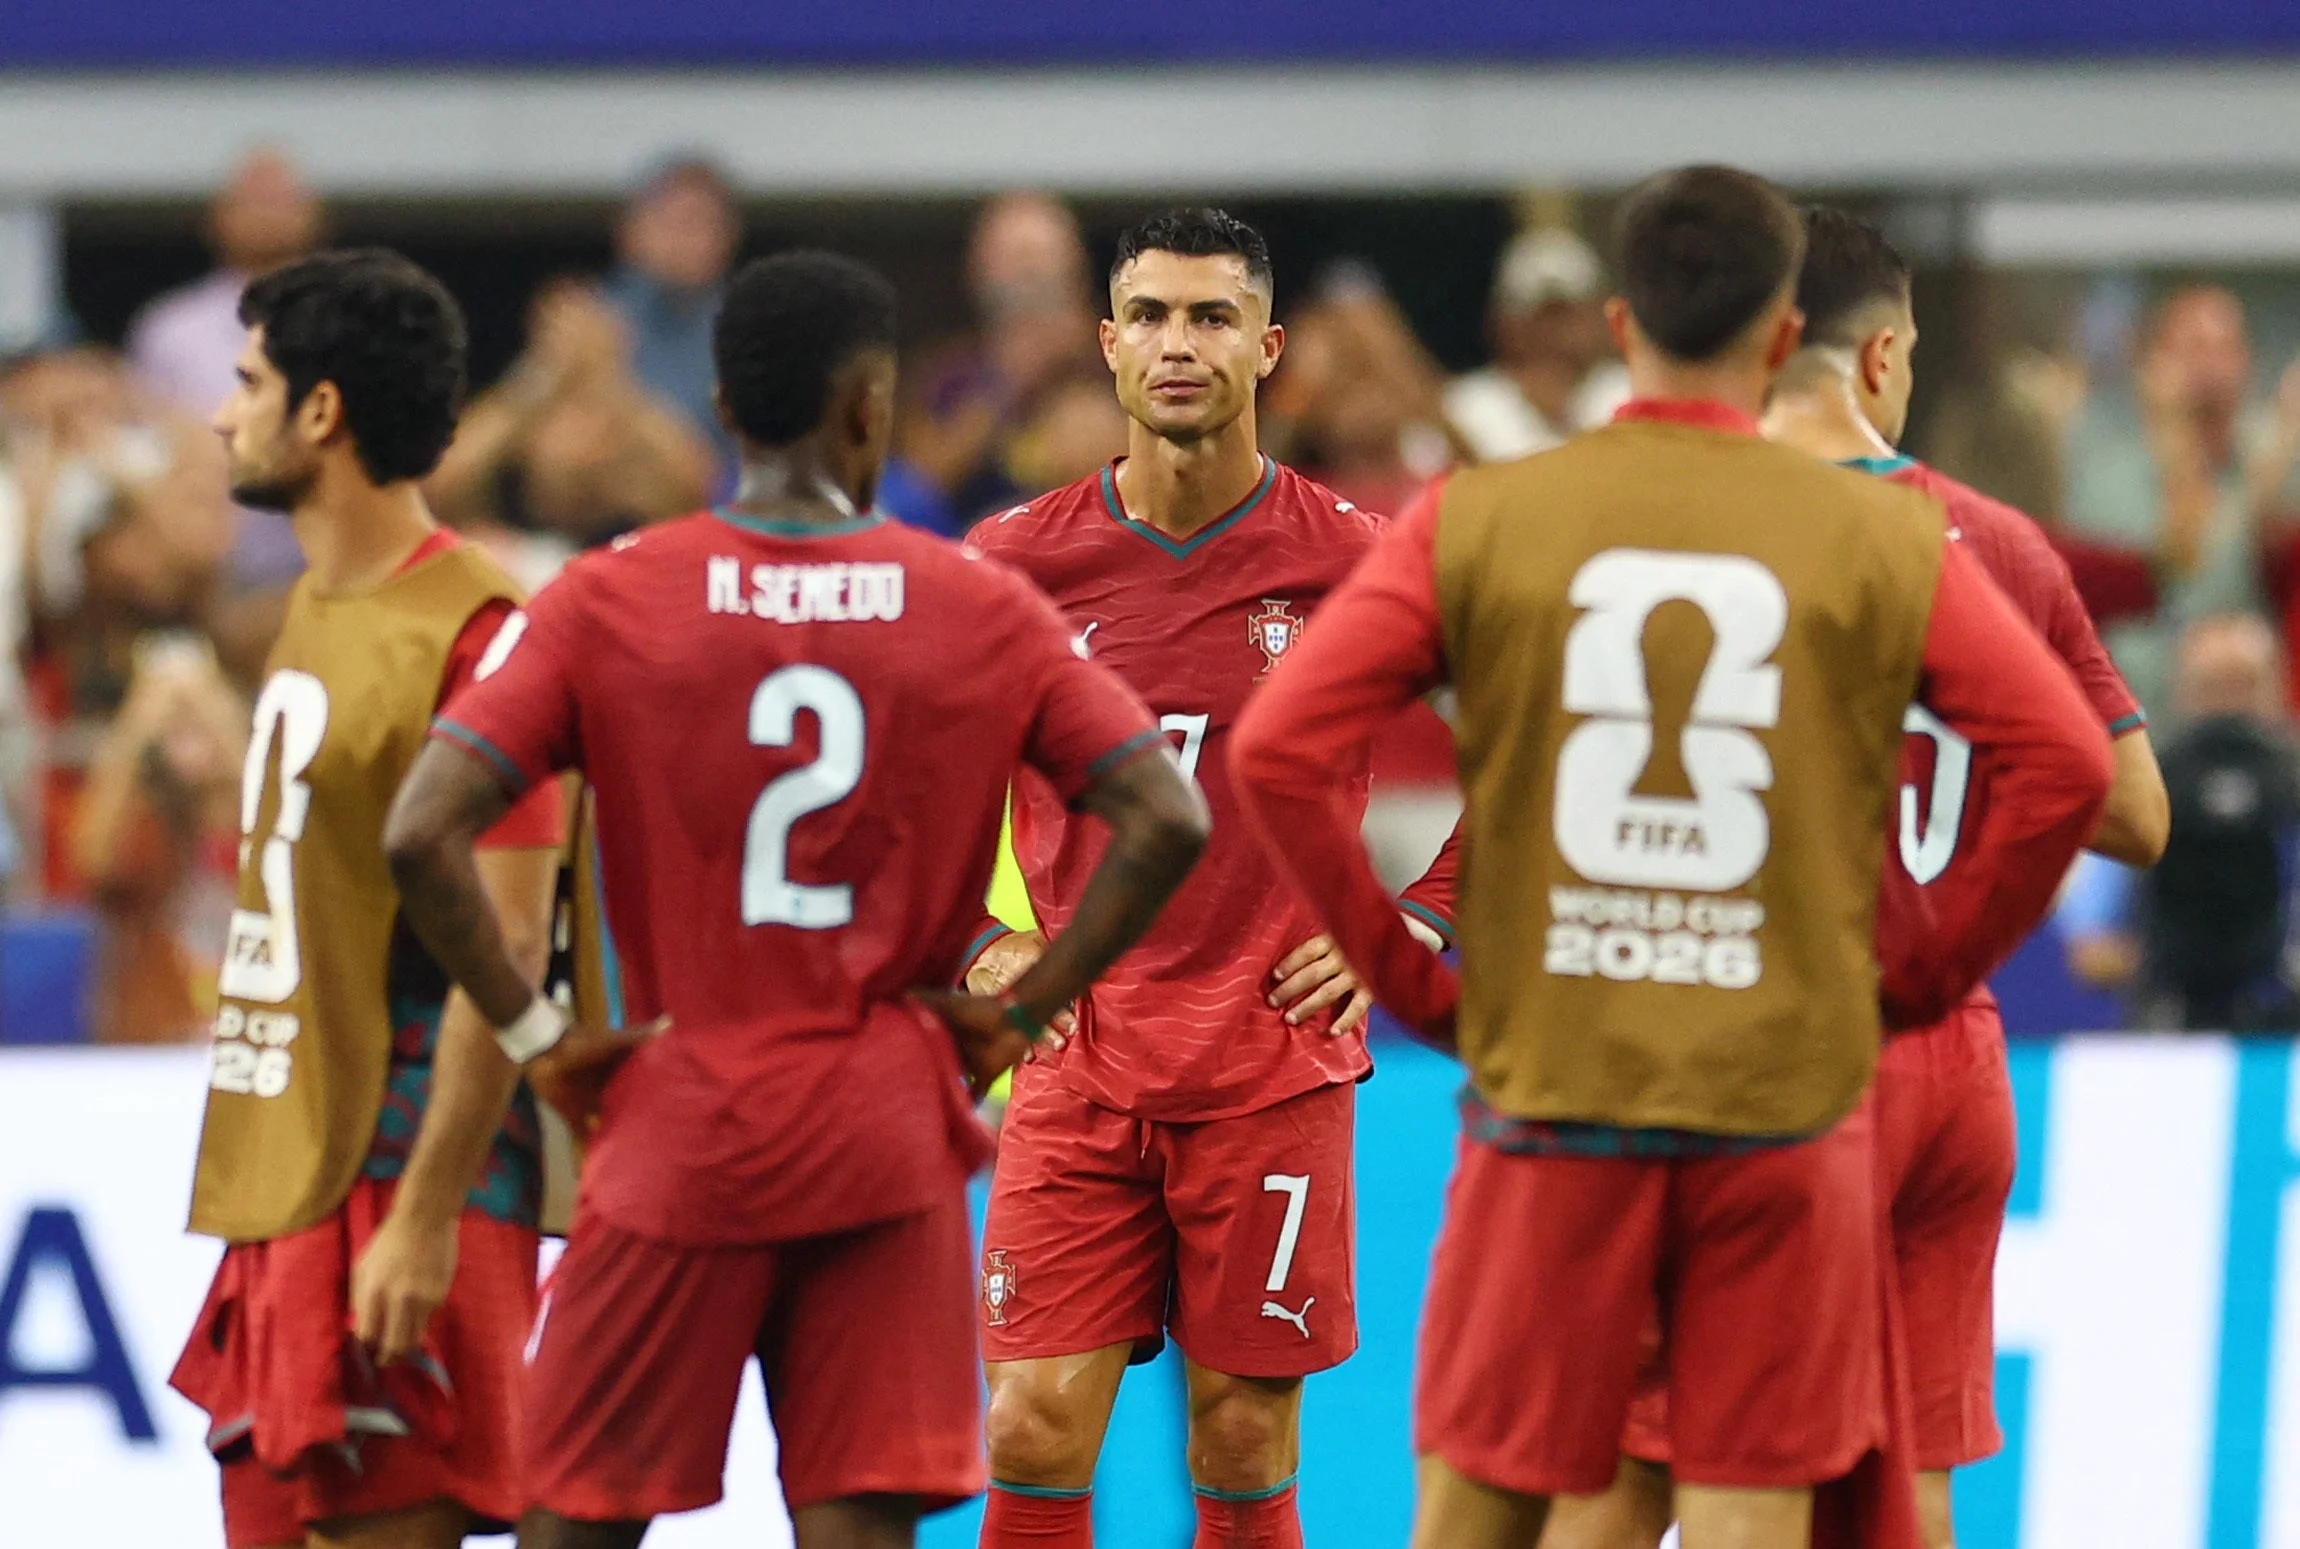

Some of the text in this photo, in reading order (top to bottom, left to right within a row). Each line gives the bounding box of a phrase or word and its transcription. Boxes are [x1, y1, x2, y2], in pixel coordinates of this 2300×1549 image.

[1160, 713, 1210, 786] 7
[741, 663, 866, 929] 2
[1614, 819, 1708, 854] FIFA
[1548, 884, 1765, 935] WORLD CUP
[1543, 921, 1763, 990] 2026
[212, 1040, 293, 1098] 26
[1263, 1174, 1311, 1292] 7
